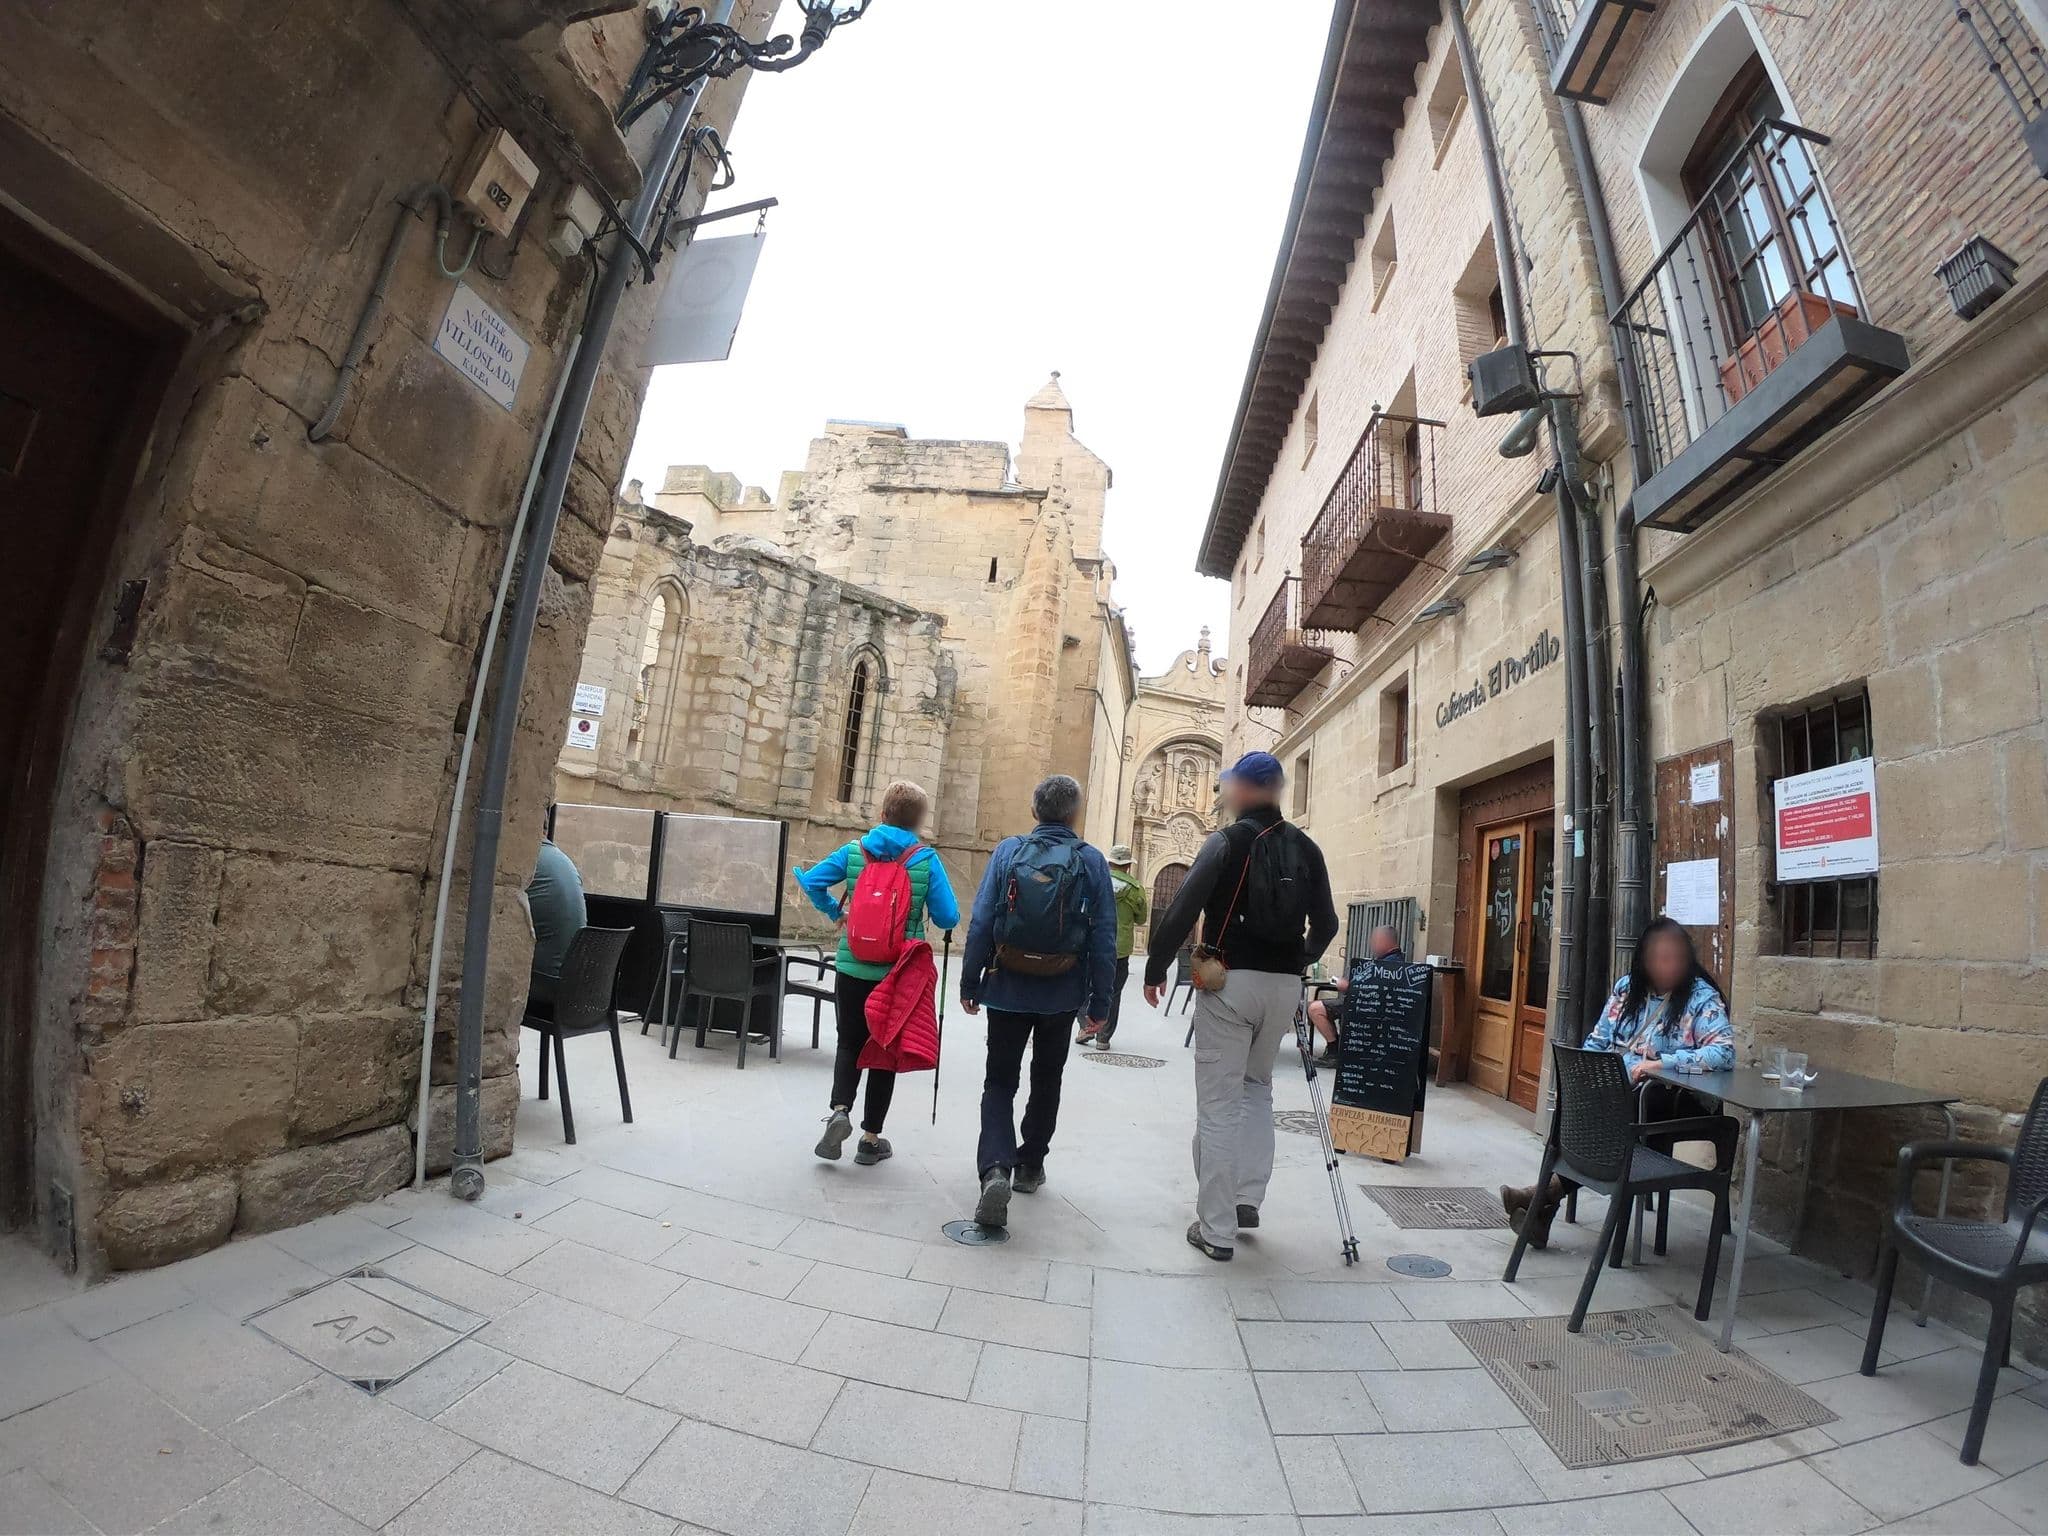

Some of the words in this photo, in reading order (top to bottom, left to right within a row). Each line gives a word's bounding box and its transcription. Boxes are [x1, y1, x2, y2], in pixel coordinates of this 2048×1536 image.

[491, 186, 508, 208] 02
[463, 309, 513, 363] NAVARRO
[481, 309, 507, 338] CALLE
[443, 319, 516, 393] VILLOSLADA
[462, 358, 489, 386] KALEA
[1488, 660, 1502, 698] El
[1503, 628, 1560, 690] Portillo
[1373, 966, 1403, 980] MENÚ
[1331, 1106, 1365, 1120] CERVEZAS
[1367, 1113, 1408, 1129] ALHAMBRA
[311, 1314, 397, 1345] AP
[1602, 1409, 1652, 1429] TC
